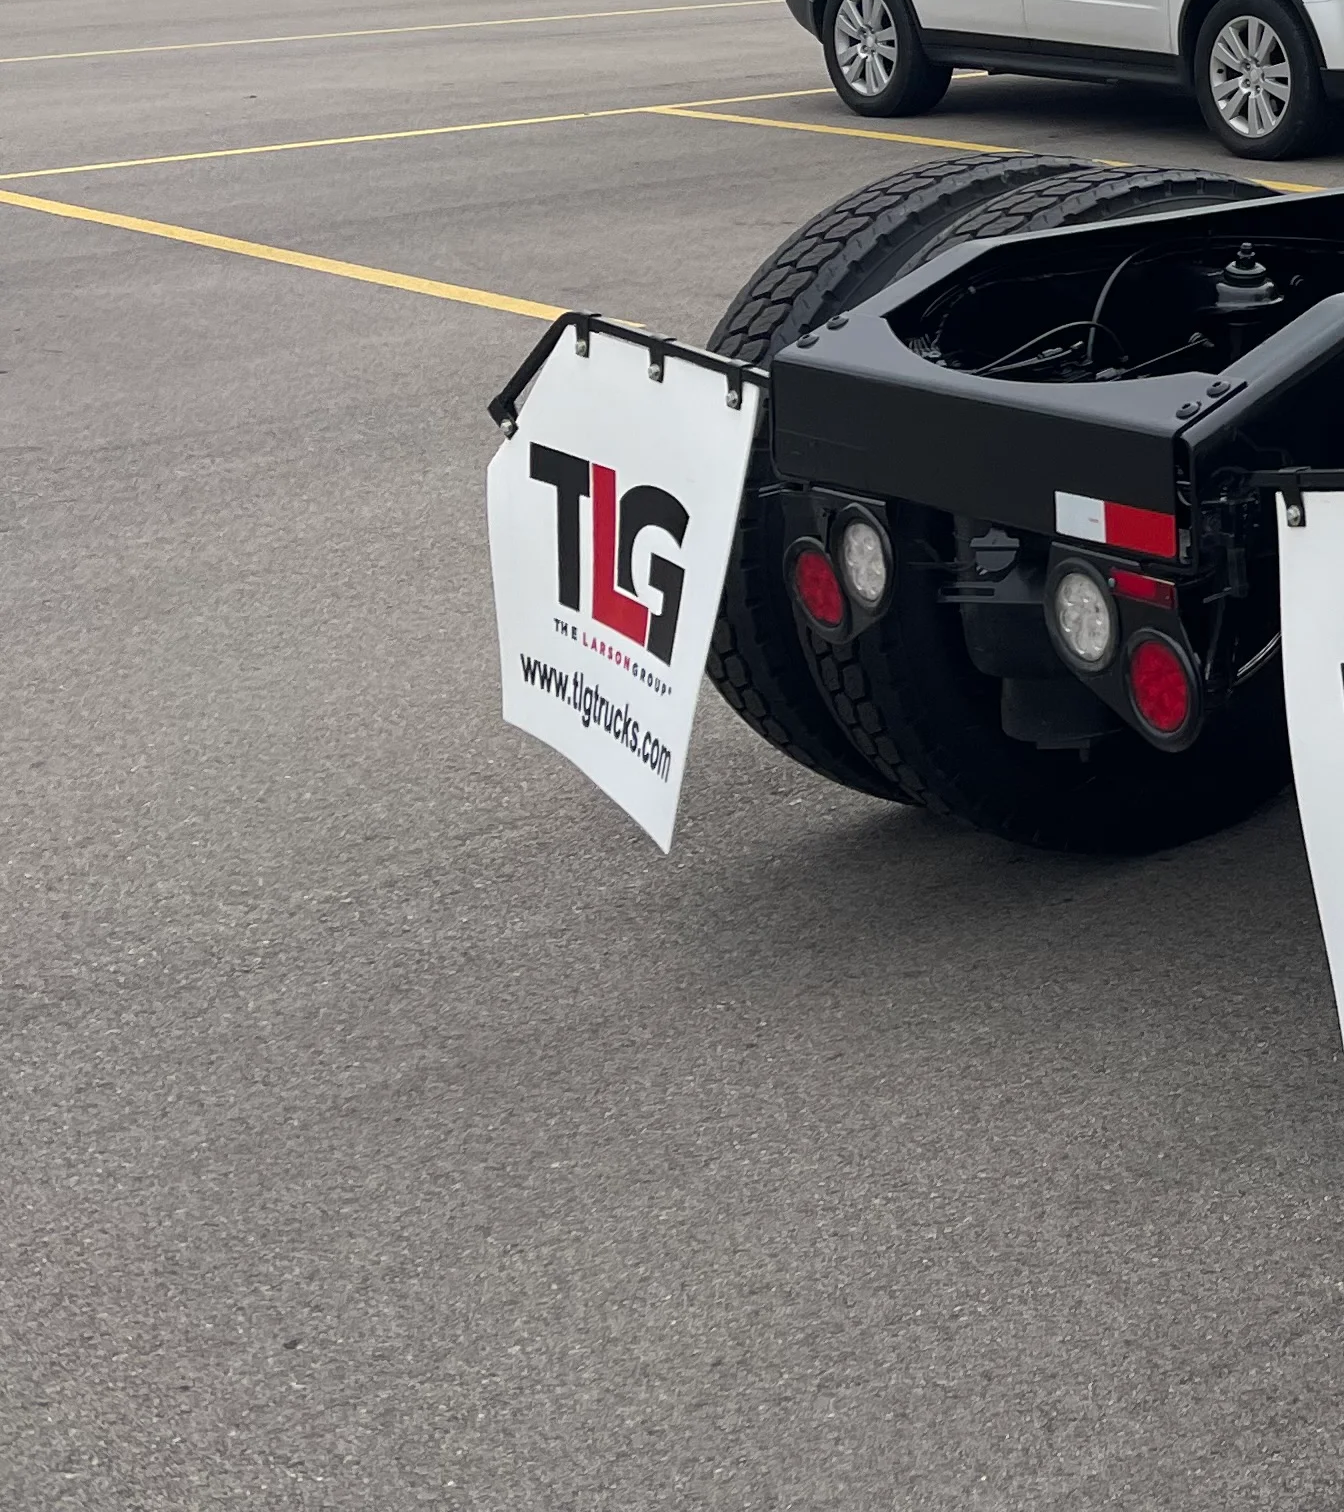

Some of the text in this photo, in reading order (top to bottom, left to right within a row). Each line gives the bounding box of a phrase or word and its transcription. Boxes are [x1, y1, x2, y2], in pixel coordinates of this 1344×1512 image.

[529, 441, 690, 667] TLG
[554, 617, 578, 641] THE
[519, 654, 671, 784] www.tlgtrucks.com
